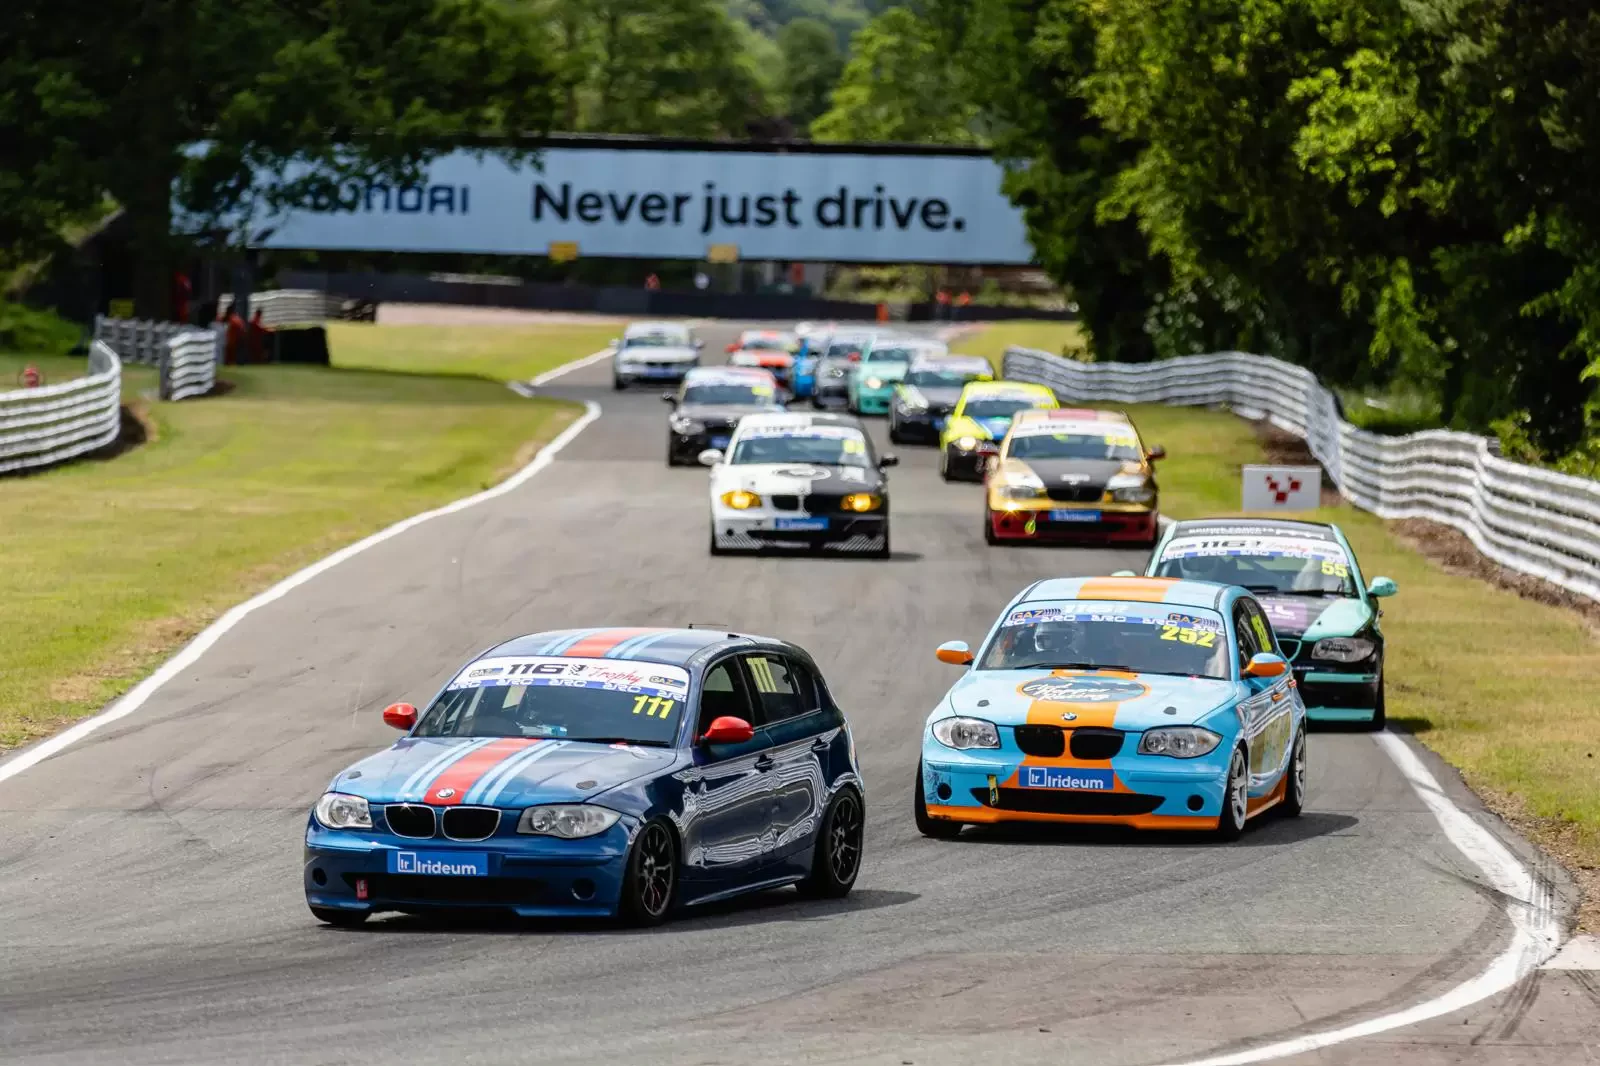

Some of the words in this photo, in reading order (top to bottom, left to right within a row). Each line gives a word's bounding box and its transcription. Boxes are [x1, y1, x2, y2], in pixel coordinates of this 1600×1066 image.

[531, 182, 692, 224] Never
[700, 182, 802, 234] just
[814, 185, 967, 232] drive.
[1322, 561, 1348, 577] 55
[1011, 609, 1044, 620] GAZ
[1168, 613, 1201, 624] GAZ
[1161, 625, 1216, 648] 252
[588, 665, 642, 685] Trophy
[632, 694, 675, 719] 111
[1048, 775, 1104, 789] Irideum
[417, 860, 477, 875] Irideum
